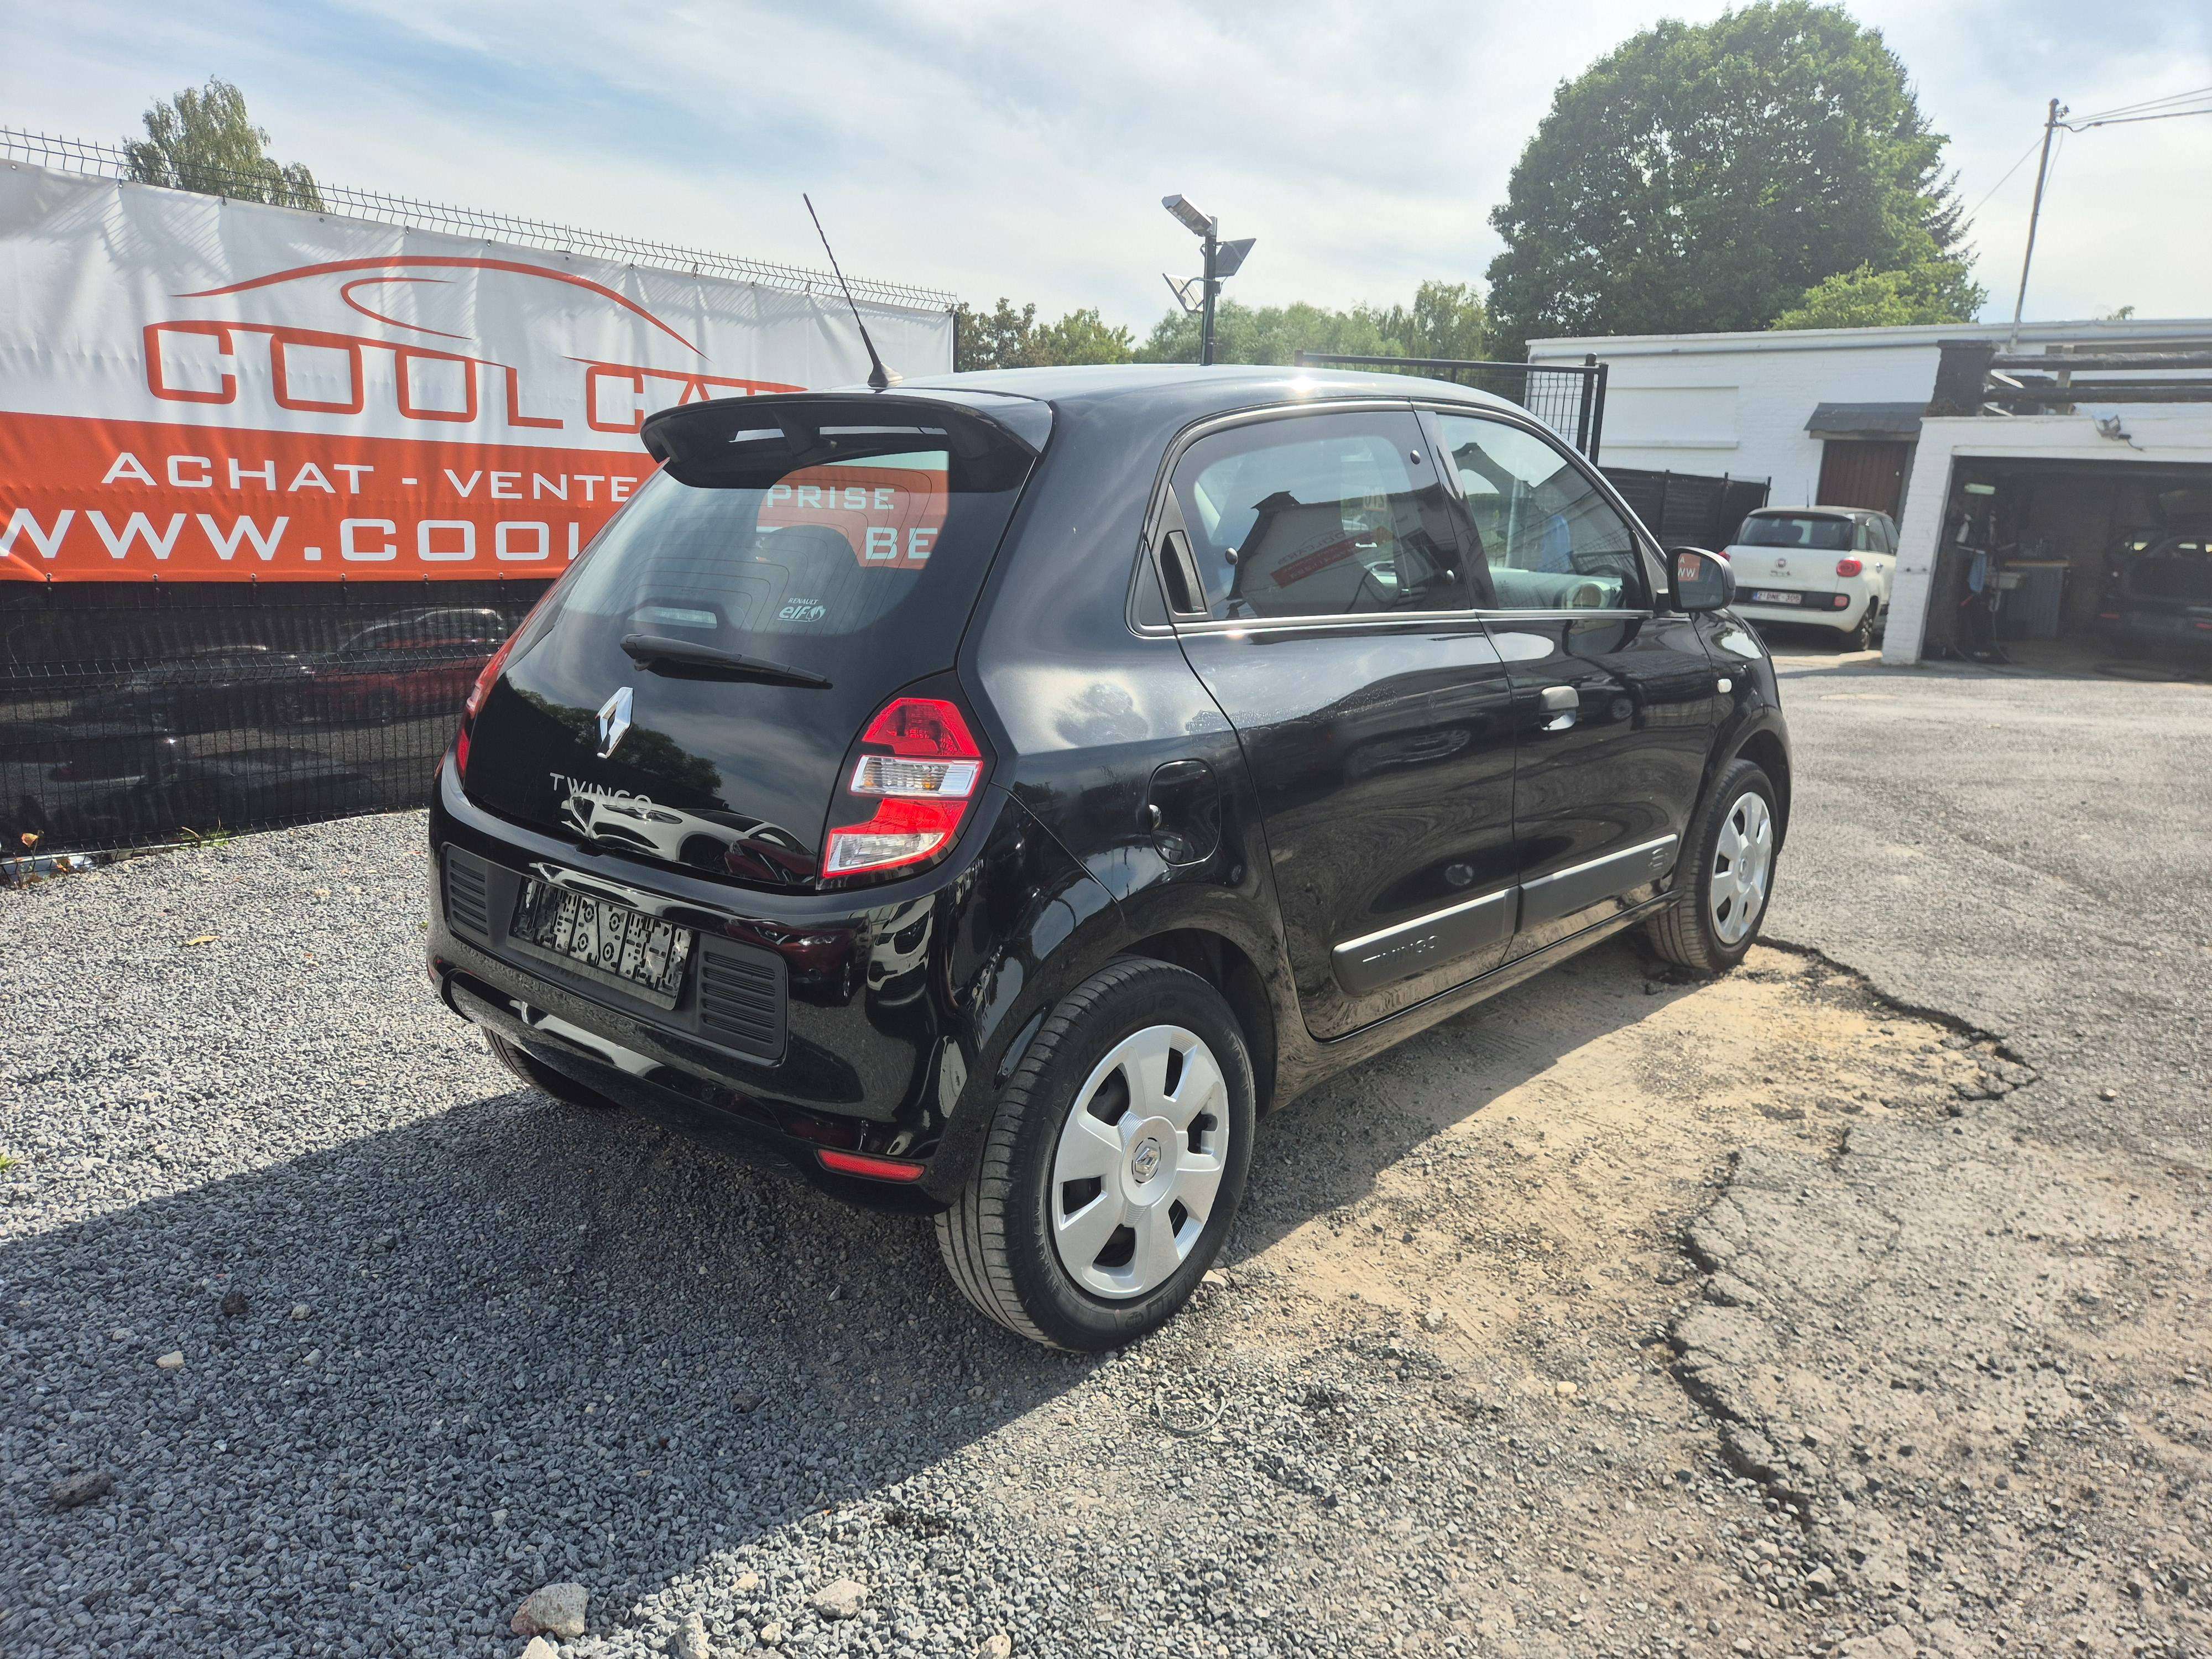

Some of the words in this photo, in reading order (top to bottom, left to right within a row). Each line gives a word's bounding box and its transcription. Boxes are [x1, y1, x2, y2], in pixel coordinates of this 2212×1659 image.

[101, 452, 374, 494] ACHAT
[444, 468, 638, 502] VENTE
[767, 484, 895, 510] PRISE
[779, 606, 811, 619] elf
[550, 772, 652, 814] TWINGO
